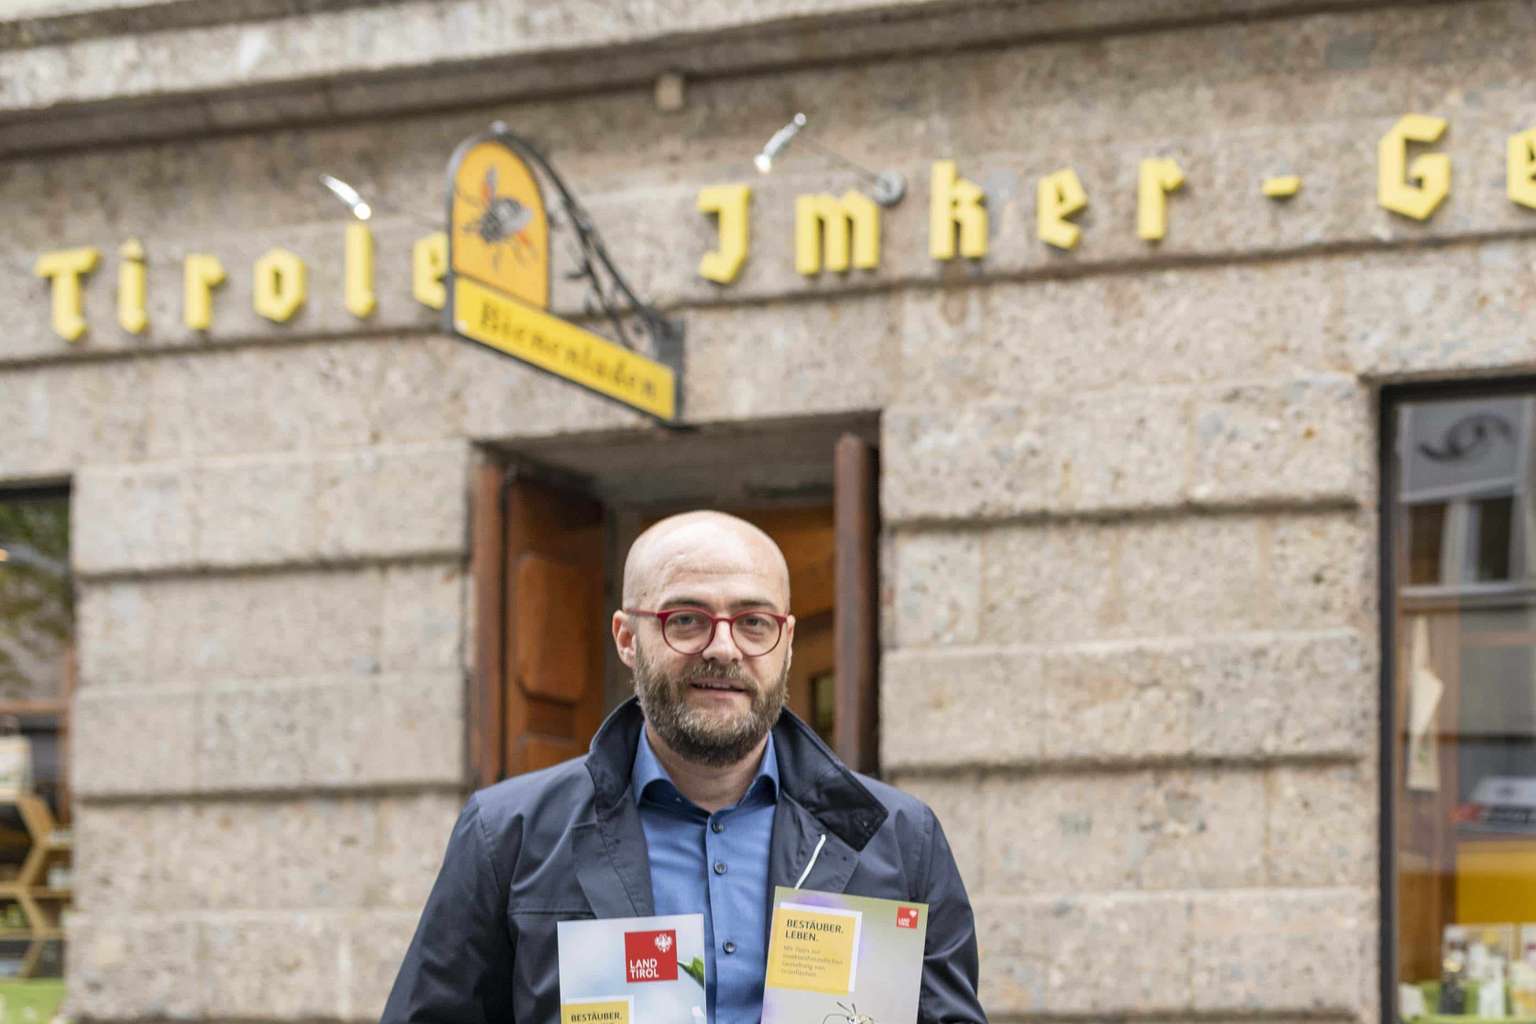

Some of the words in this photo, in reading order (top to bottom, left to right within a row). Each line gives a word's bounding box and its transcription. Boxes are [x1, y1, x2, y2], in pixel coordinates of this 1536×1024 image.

[35, 222, 449, 341] Tirole
[630, 957, 658, 969] LAND
[629, 967, 660, 979] TIROL
